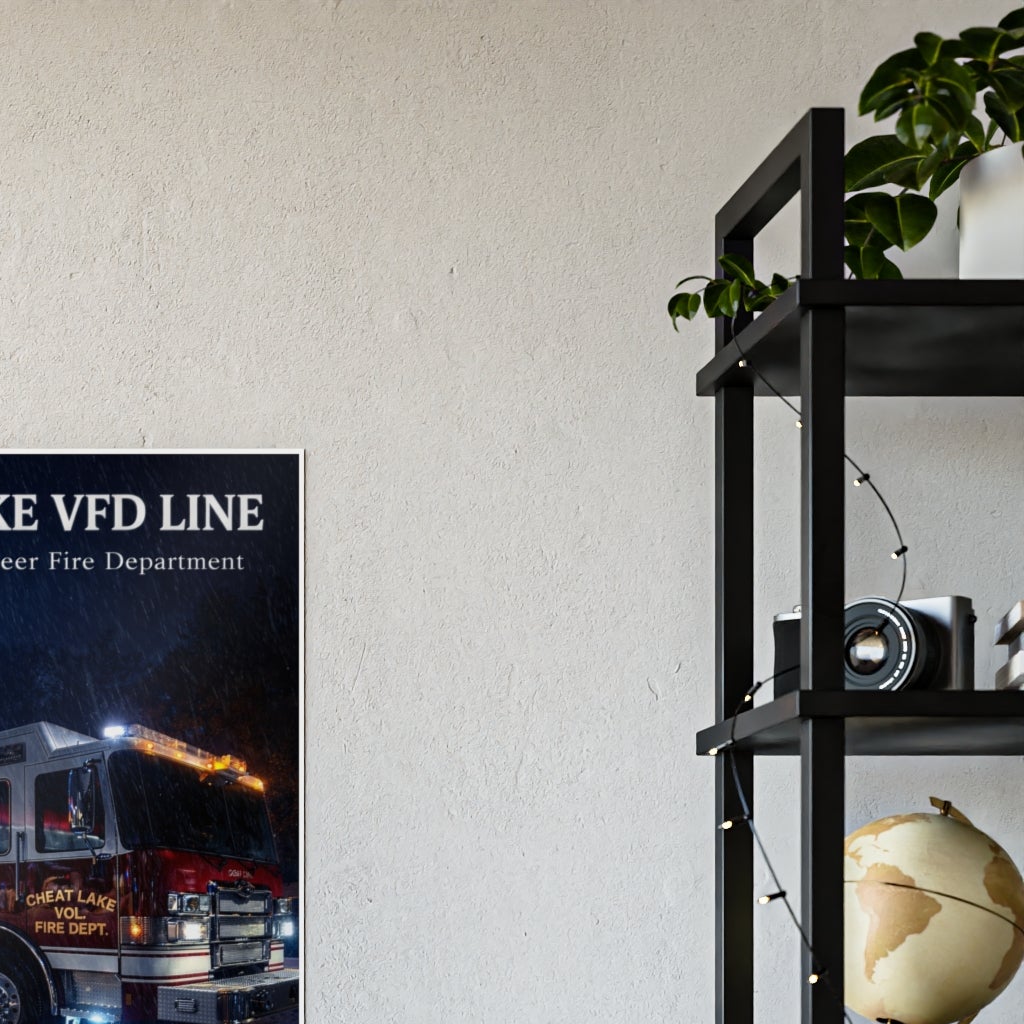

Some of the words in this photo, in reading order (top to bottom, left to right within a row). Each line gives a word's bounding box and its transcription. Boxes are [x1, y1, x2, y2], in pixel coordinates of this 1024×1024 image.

[50, 493, 146, 532] VFD
[159, 493, 264, 532] LINE
[49, 550, 95, 571] Fire
[105, 550, 244, 576] Department
[26, 889, 74, 907] CHEAT
[77, 890, 117, 912] LAKE
[54, 906, 86, 920] VOL.
[34, 920, 65, 934] FIRE
[68, 921, 109, 936] DEPT.
